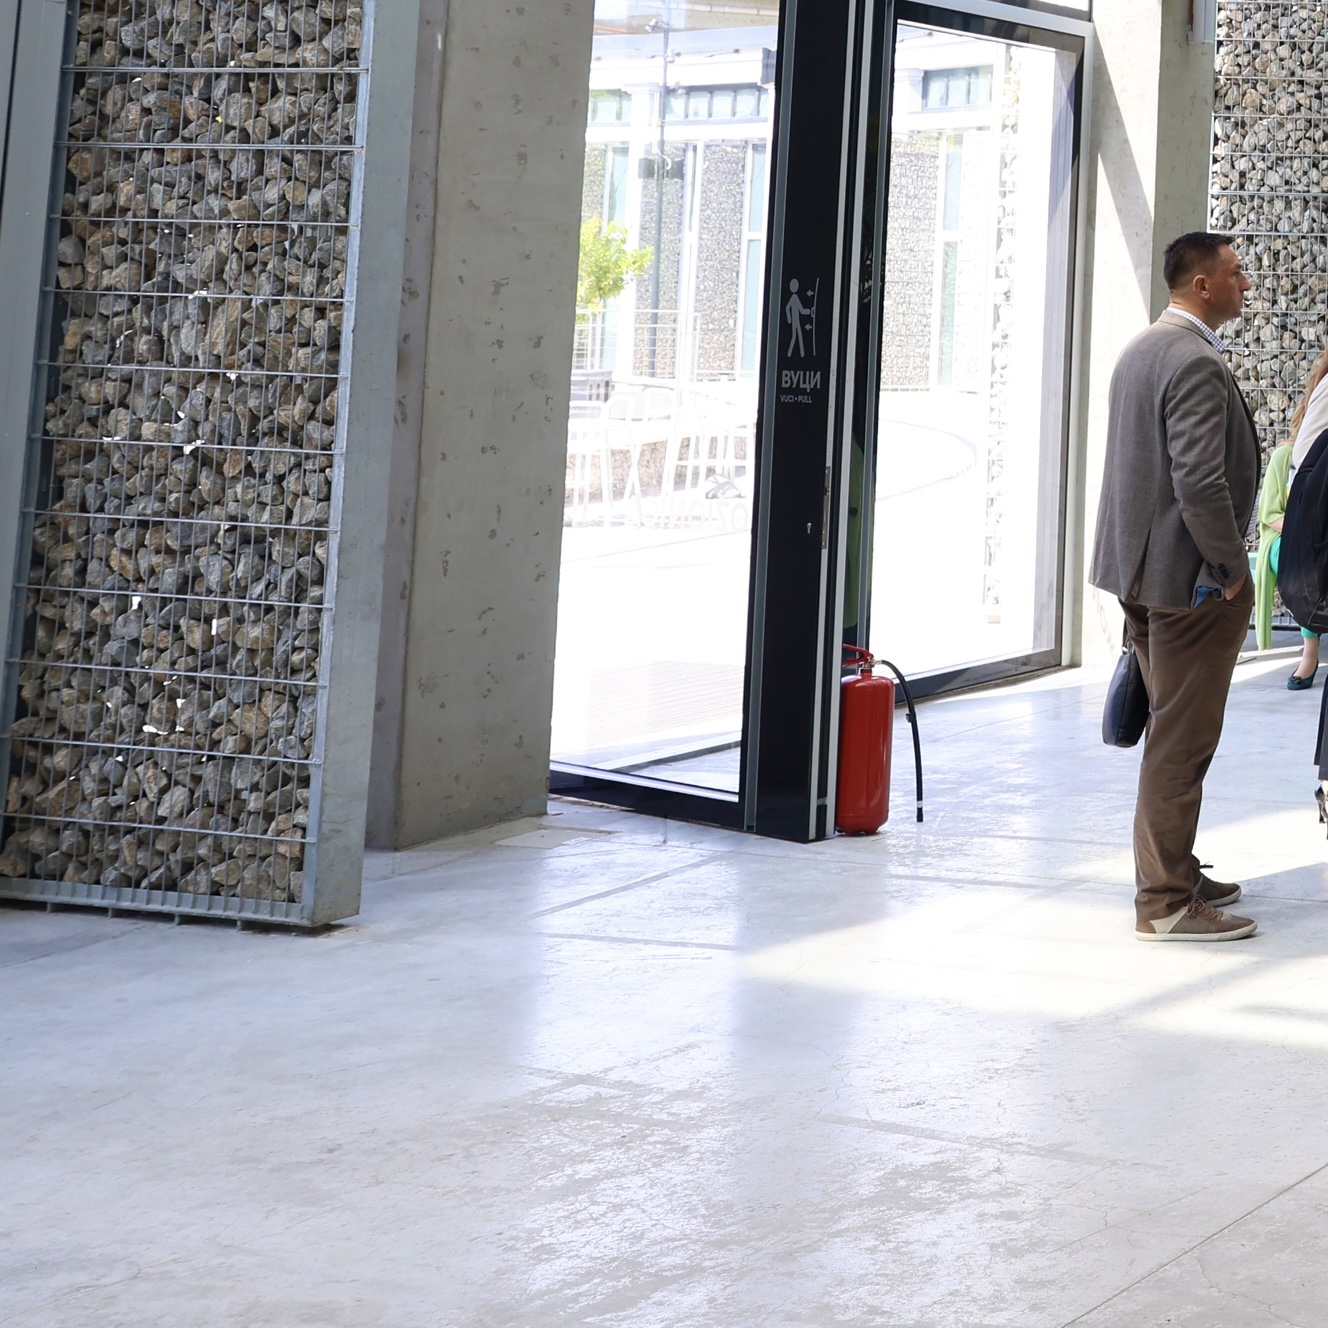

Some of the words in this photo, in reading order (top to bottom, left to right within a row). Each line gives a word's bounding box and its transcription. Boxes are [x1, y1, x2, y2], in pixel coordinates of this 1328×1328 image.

[781, 370, 821, 392] ВУЦИ
[780, 394, 795, 403] VUCI
[798, 395, 813, 404] PULL
